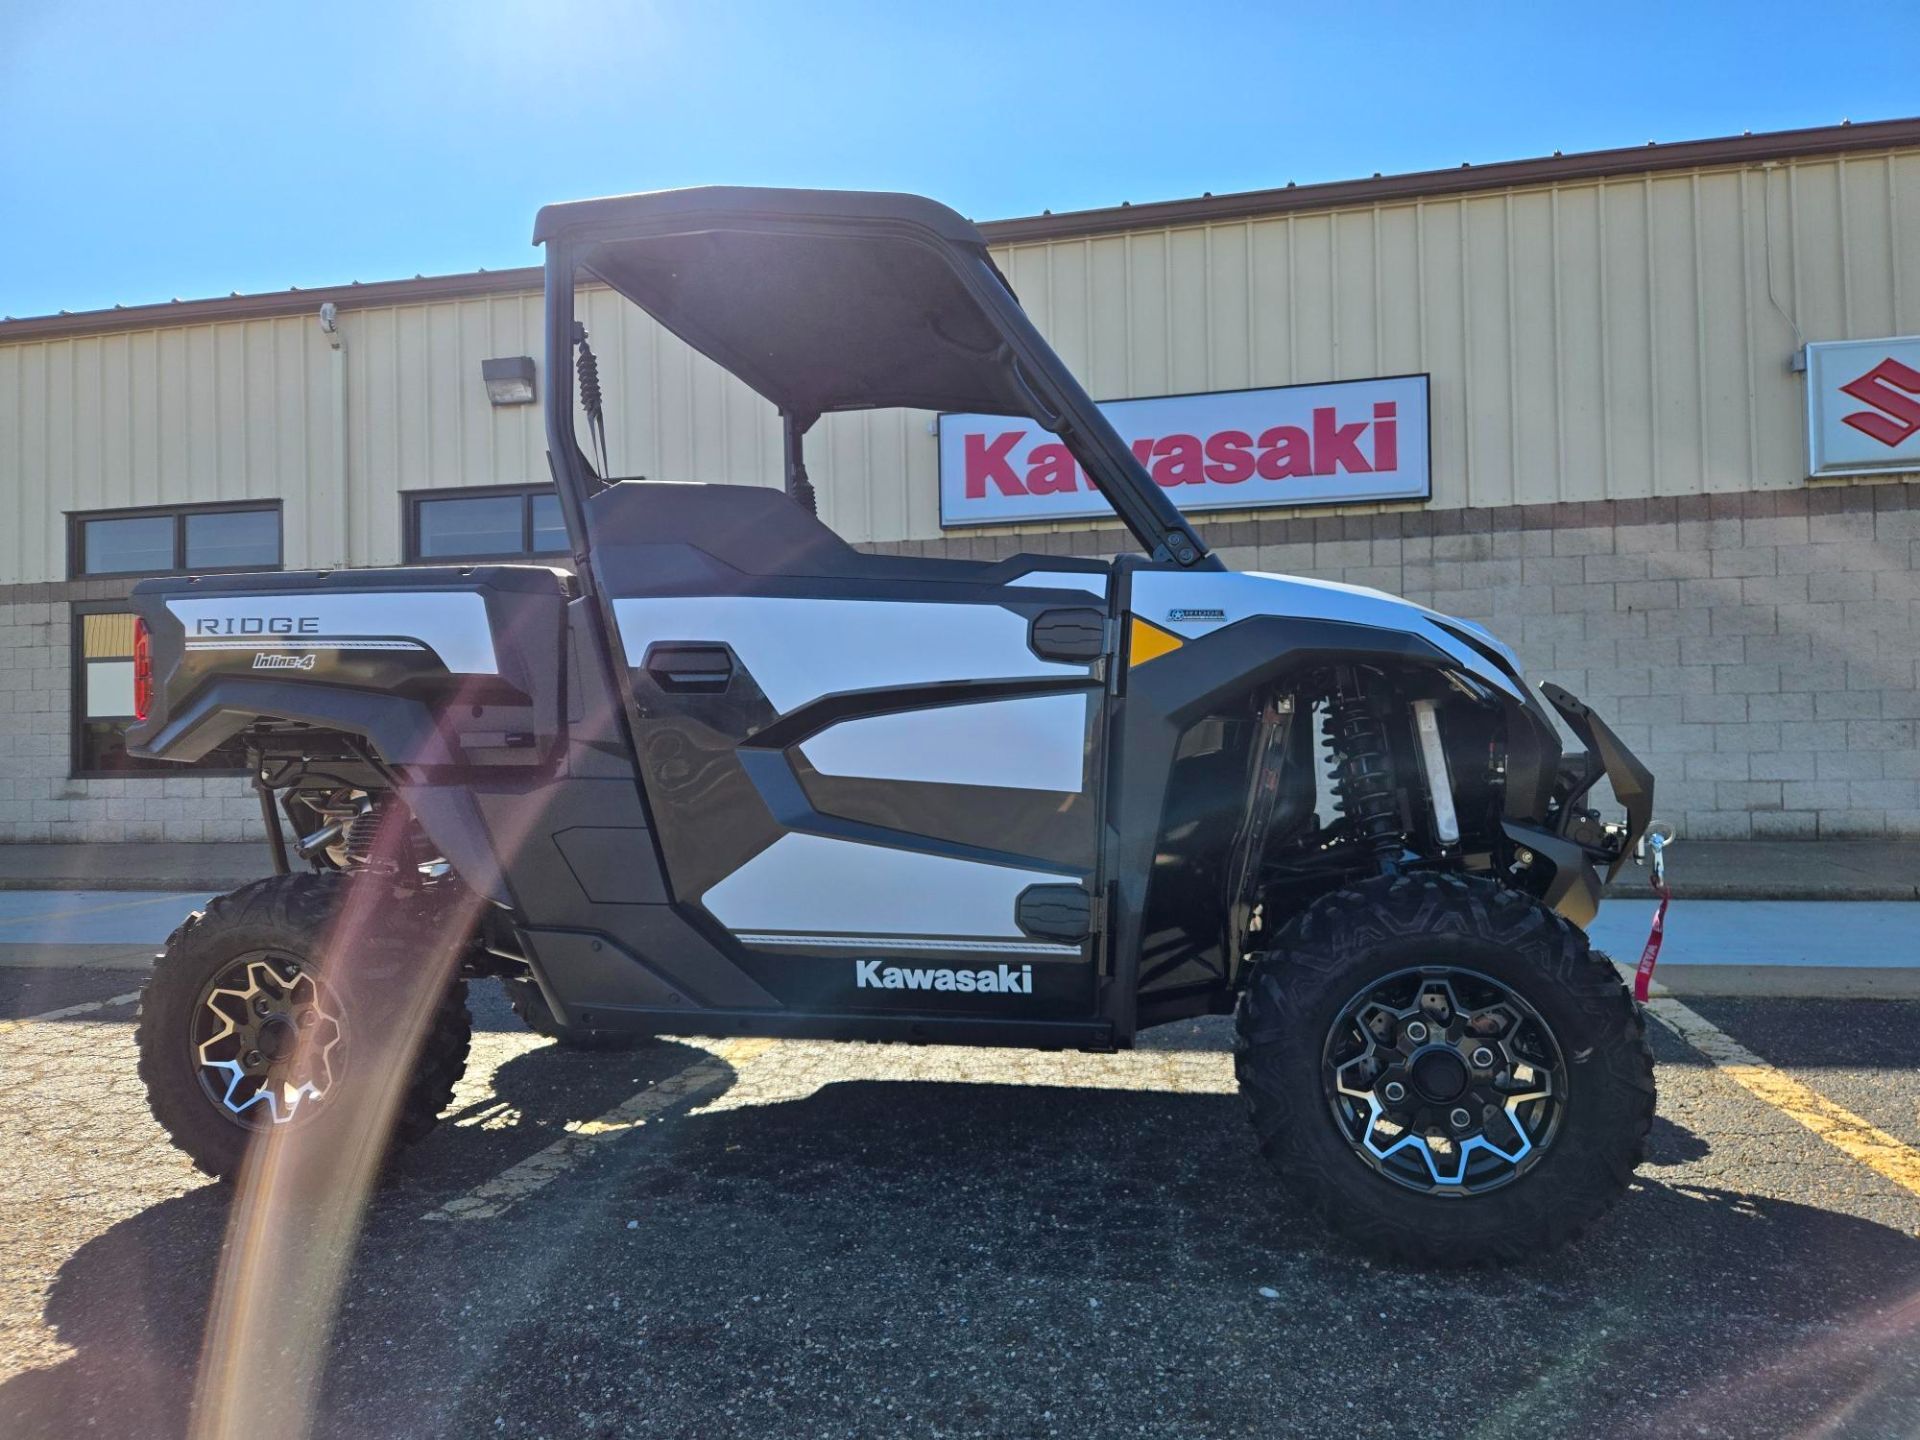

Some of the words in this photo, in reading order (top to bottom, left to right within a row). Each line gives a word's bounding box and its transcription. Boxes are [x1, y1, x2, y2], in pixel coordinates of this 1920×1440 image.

[197, 617, 320, 634] RIDGE
[252, 652, 316, 670] Inline-4
[856, 960, 1032, 994] Kawasaki
